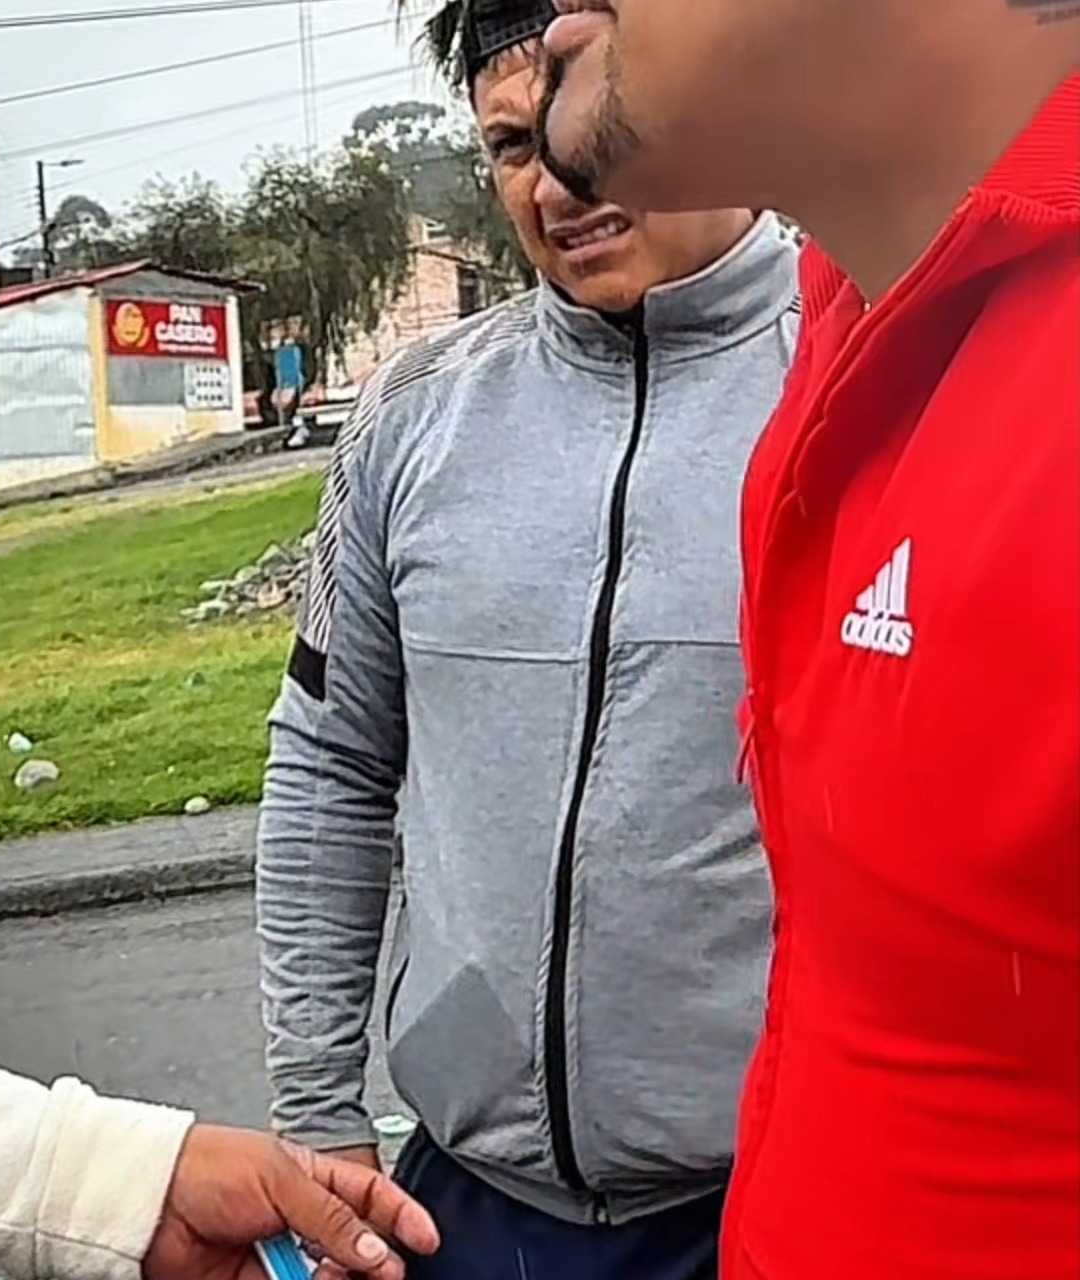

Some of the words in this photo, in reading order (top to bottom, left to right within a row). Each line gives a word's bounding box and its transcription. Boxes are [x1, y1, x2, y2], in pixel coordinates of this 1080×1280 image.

[169, 304, 202, 323] PAN
[155, 320, 218, 344] CASERO
[841, 609, 914, 657] adidas
